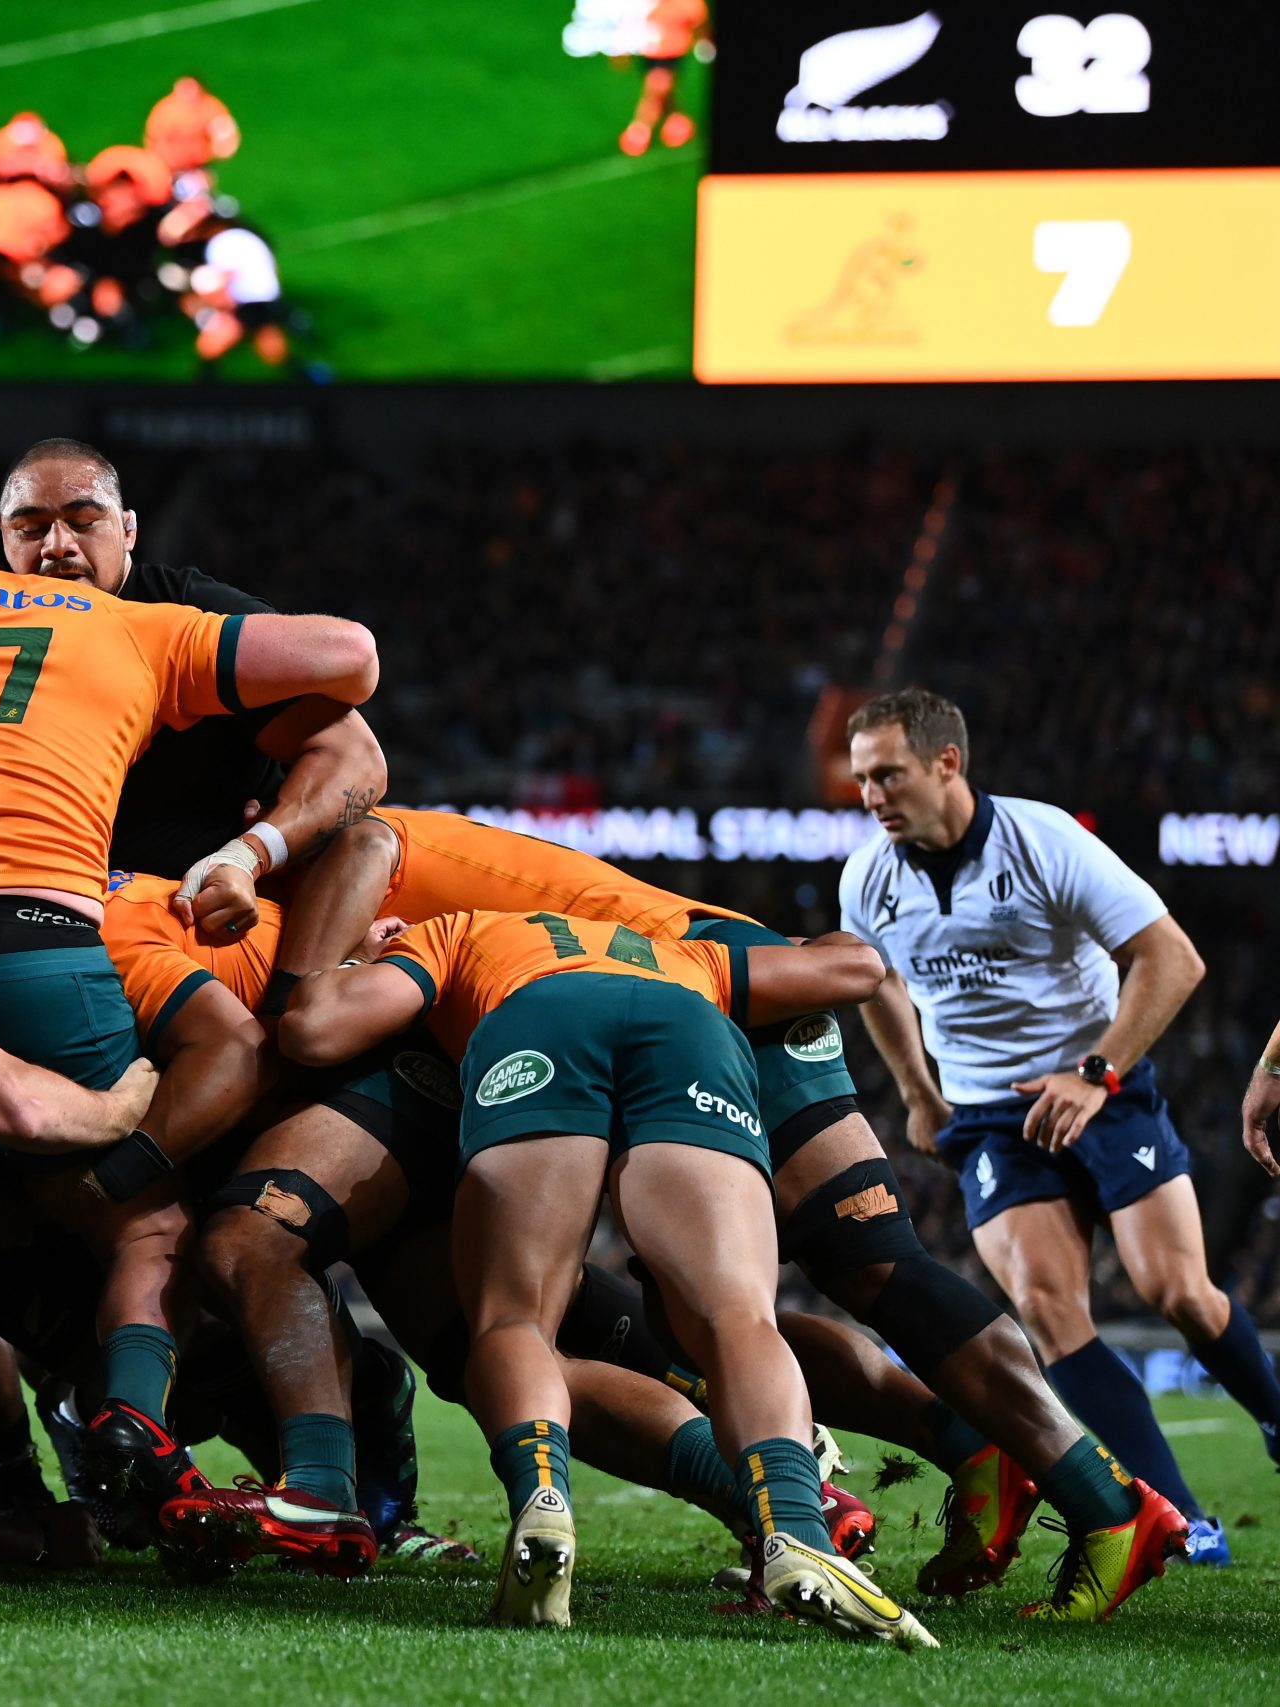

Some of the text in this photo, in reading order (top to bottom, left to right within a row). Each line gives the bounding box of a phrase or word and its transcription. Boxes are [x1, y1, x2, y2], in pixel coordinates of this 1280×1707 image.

[1014, 13, 1151, 117] 32
[1033, 220, 1131, 327] 7
[489, 1060, 523, 1085] LAND
[491, 1070, 537, 1097] ROVER
